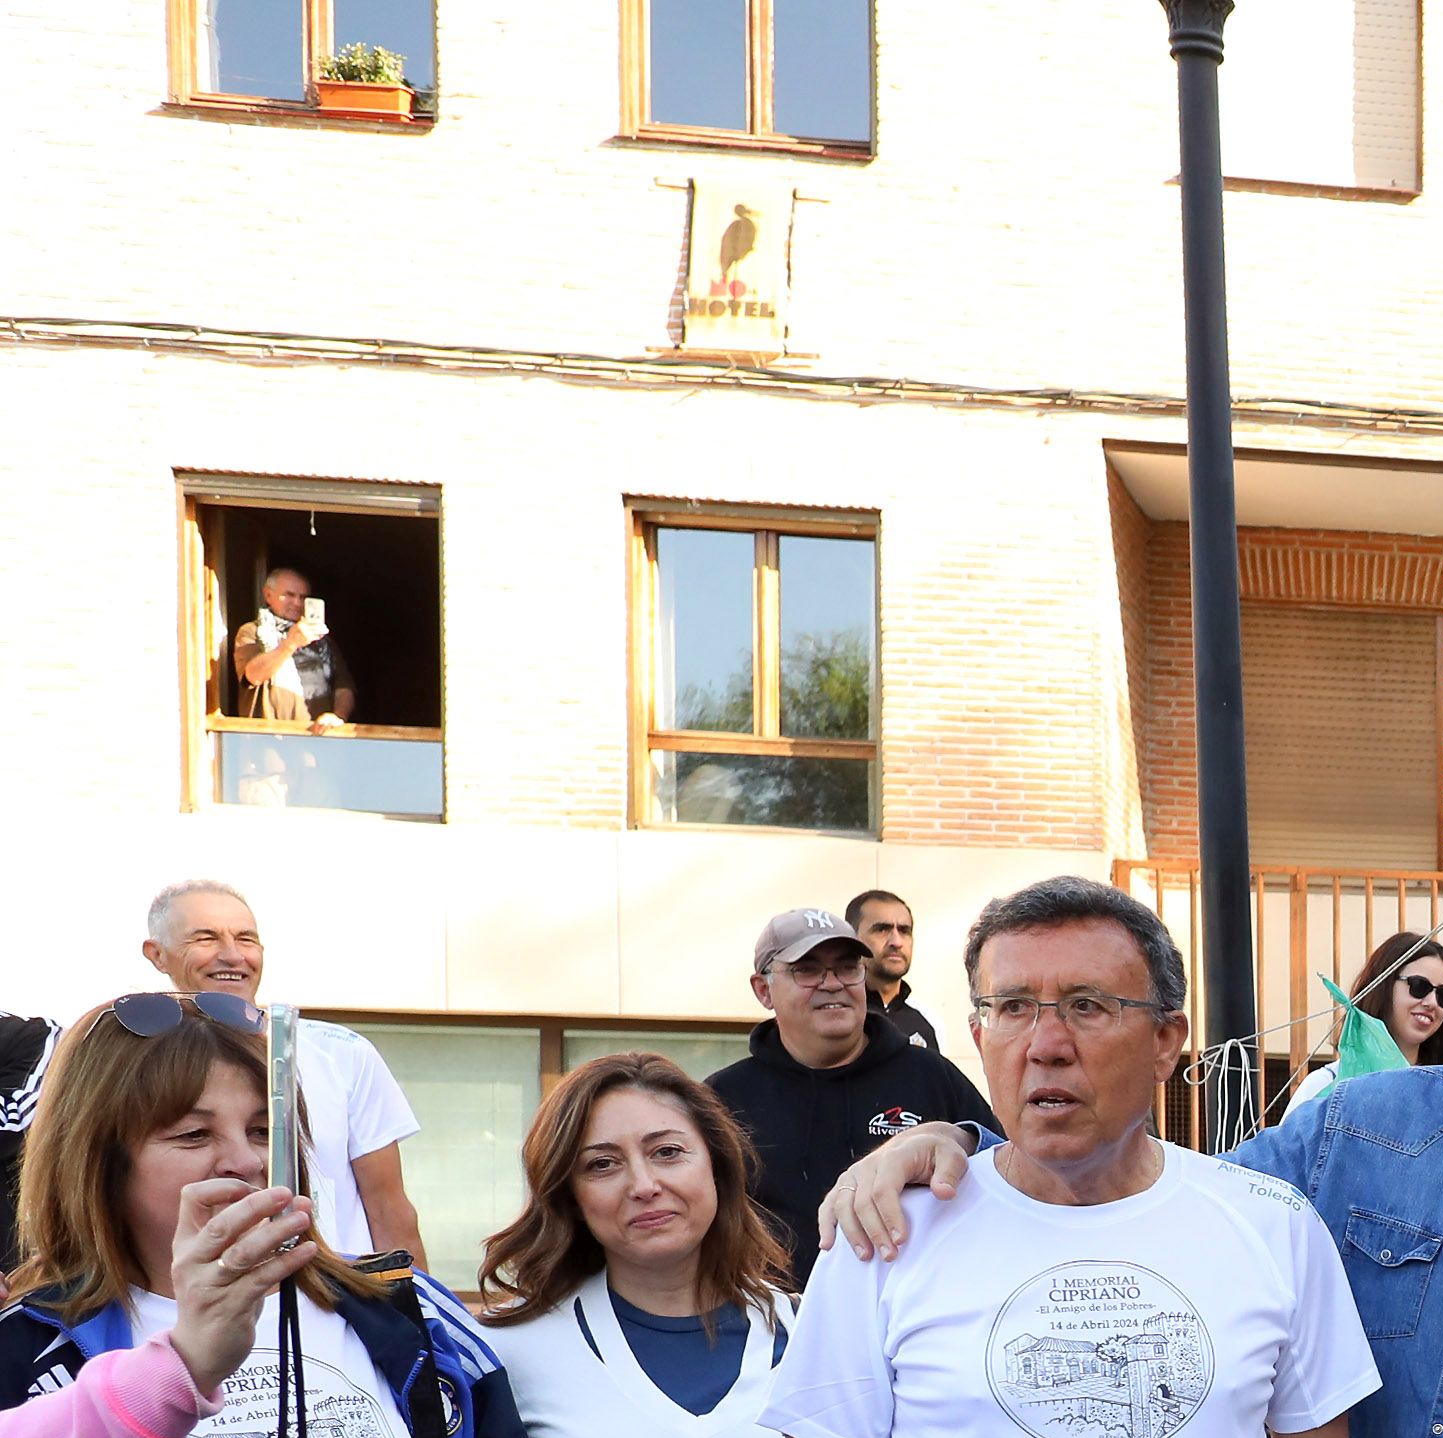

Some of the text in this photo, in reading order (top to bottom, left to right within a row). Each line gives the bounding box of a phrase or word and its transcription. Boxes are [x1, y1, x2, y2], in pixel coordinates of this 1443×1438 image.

[1248, 1182, 1301, 1212] Toledo
[1052, 1276, 1140, 1288] I MEMORIAL
[1048, 1286, 1141, 1302] CIPRIANO
[1052, 1304, 1087, 1314] Amigo
[1088, 1303, 1101, 1312] de
[1103, 1303, 1118, 1312] los
[1050, 1319, 1138, 1331] 14 de Abril 2024
[251, 1393, 264, 1401] de
[211, 1417, 226, 1427] 14
[246, 1408, 280, 1421] Abril
